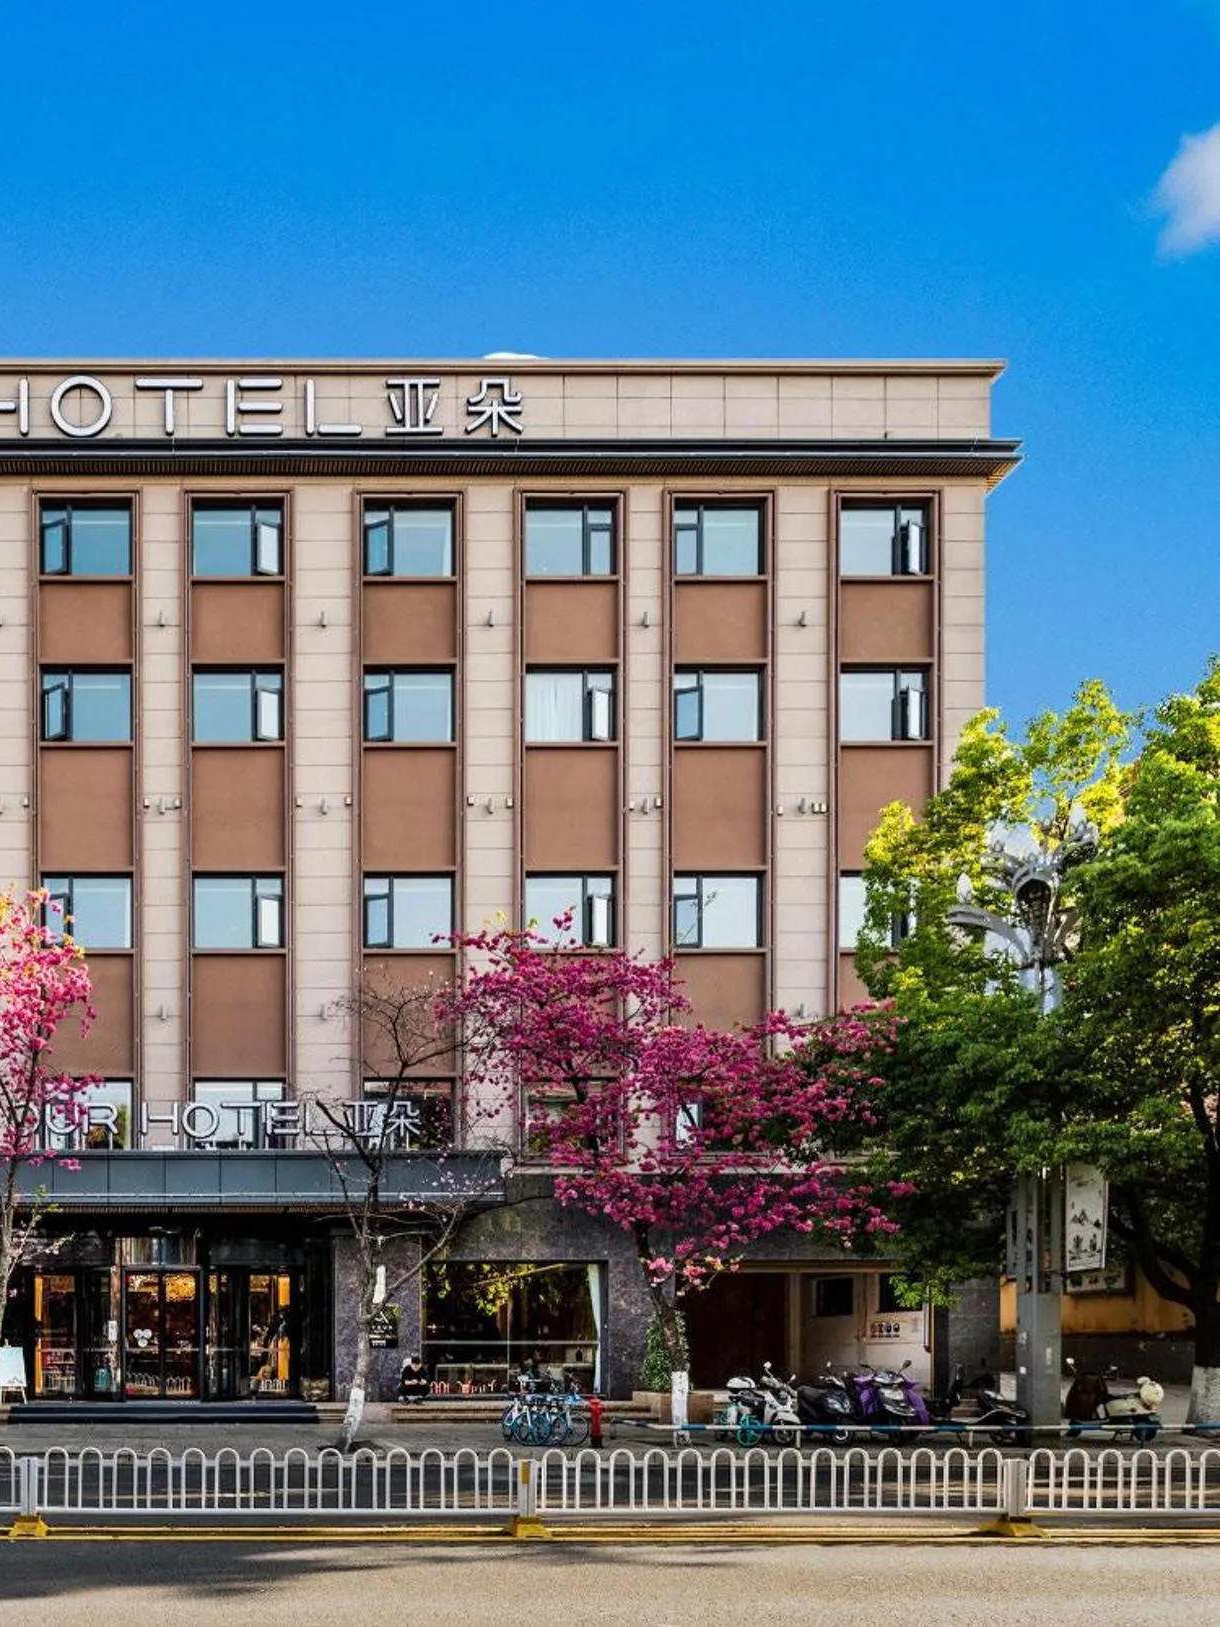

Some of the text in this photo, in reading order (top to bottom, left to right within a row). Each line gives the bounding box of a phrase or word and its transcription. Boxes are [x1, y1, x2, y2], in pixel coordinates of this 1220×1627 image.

[384, 377, 525, 437] 亚朵
[139, 1101, 339, 1138] HOTEL
[341, 1100, 421, 1138] 亚朵
